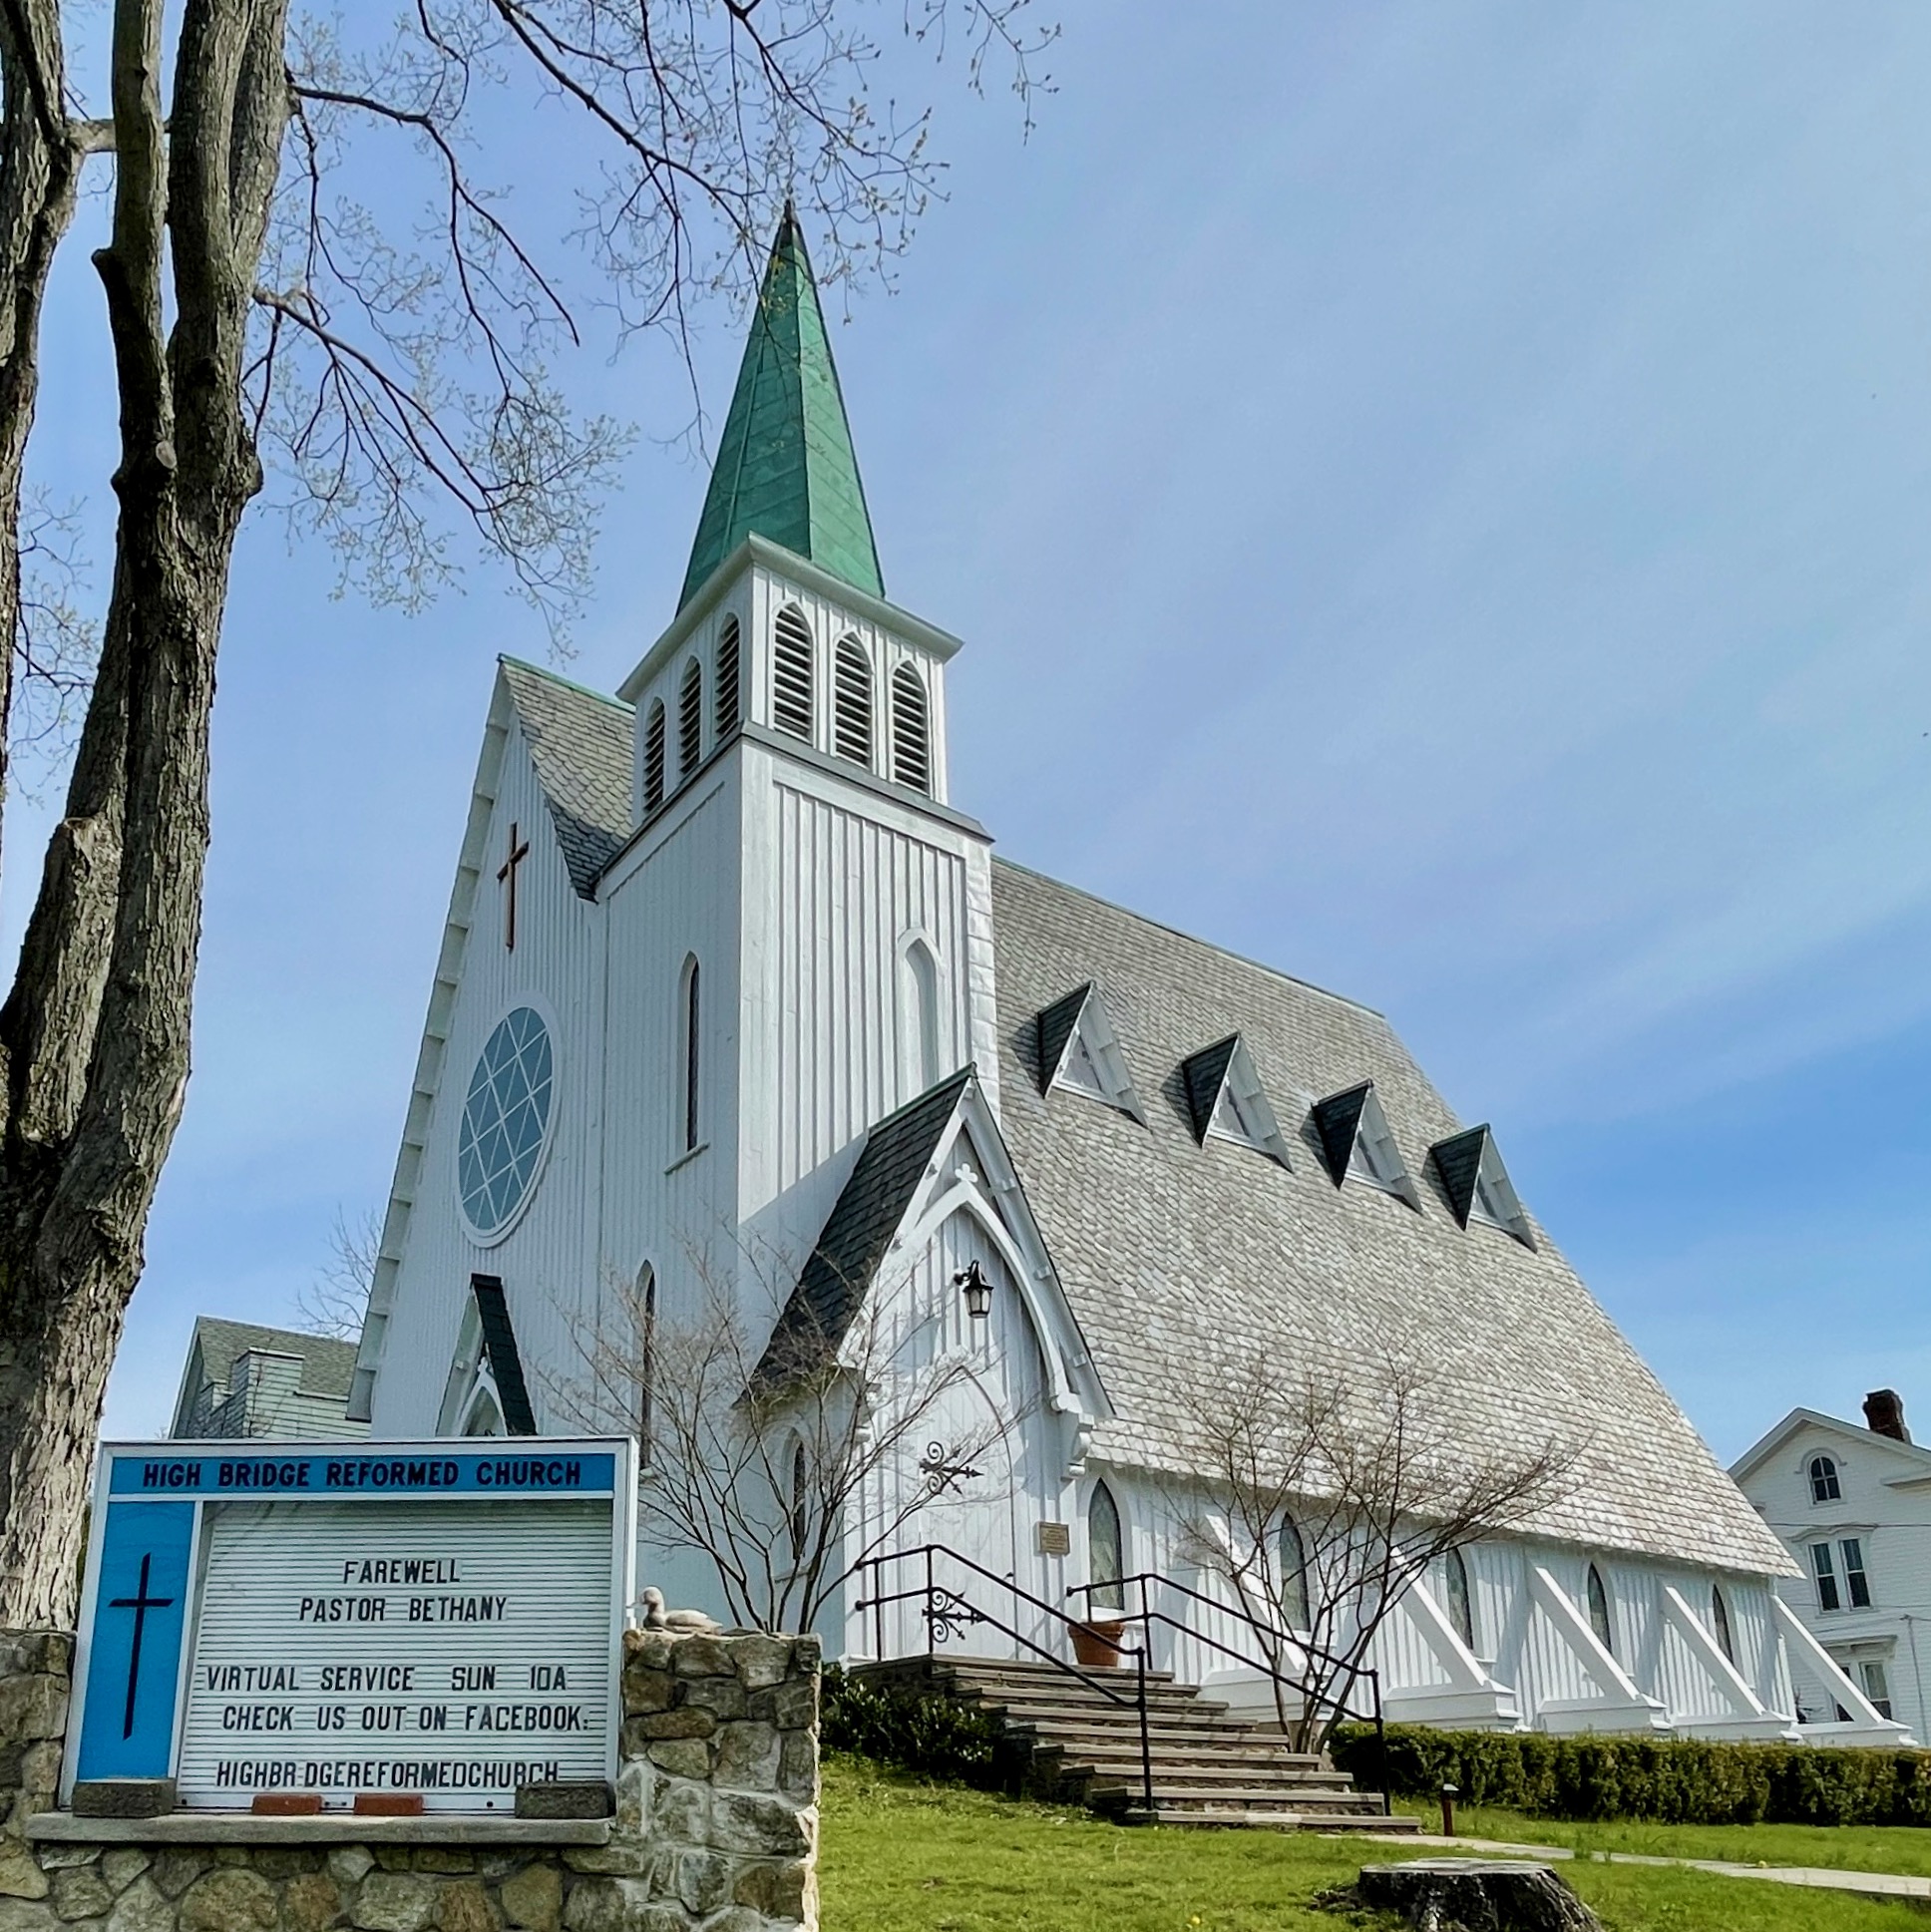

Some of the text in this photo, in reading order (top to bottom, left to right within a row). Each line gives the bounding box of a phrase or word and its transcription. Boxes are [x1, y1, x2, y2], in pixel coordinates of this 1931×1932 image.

[143, 1460, 581, 1487] HIGH BRIDGE REFORMED CHURCH
[343, 1559, 461, 1584] FAREWELL
[299, 1597, 508, 1623] PASTOR BETHANY
[206, 1666, 567, 1691] VIRTUAL SERVICE SUN 10A
[222, 1706, 589, 1731] CHECK US OUT ON FACEBOOK:
